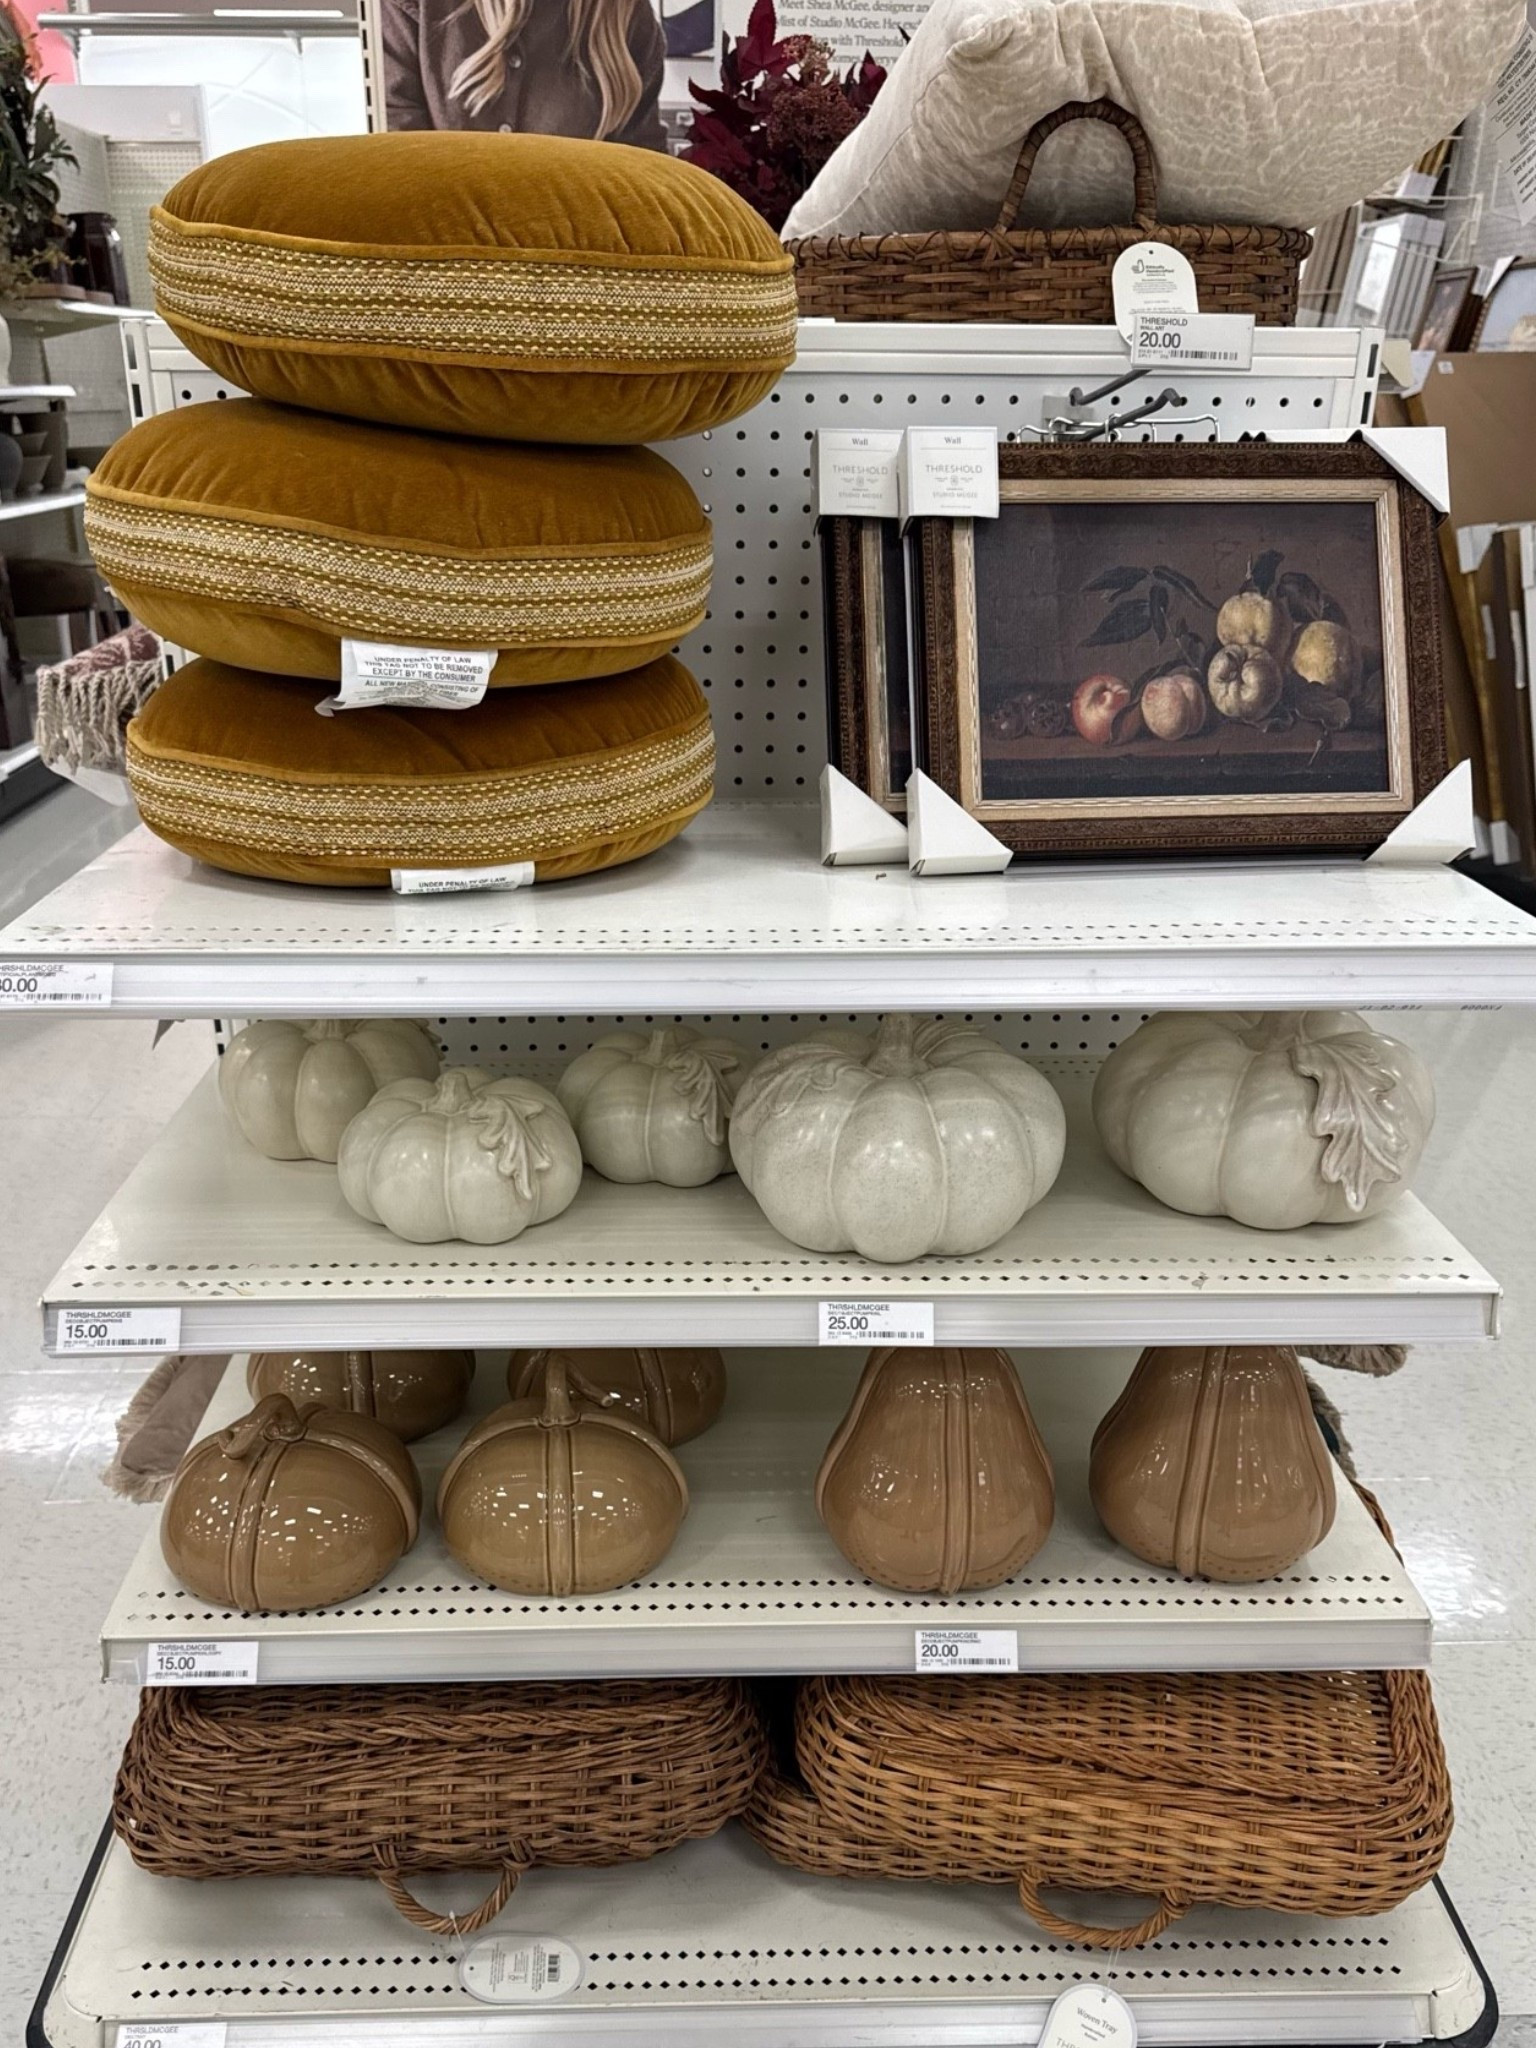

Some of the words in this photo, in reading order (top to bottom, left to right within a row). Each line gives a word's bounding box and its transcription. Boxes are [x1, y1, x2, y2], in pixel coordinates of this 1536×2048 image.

[779, 0, 805, 10] Meet
[806, 0, 832, 10] Shea
[872, 0, 915, 15] designer
[916, 4, 931, 13] an
[797, 15, 809, 27] of
[810, 16, 843, 28] Studio
[882, 18, 900, 30] Her
[831, 35, 853, 47] with
[854, 35, 904, 48] Threshold
[1141, 316, 1188, 326] THRESHOLD
[1139, 331, 1182, 349] 20.00
[852, 438, 869, 446] Wall
[944, 437, 962, 445] Wall
[832, 464, 889, 476] THRESHOLD
[925, 463, 983, 475] THRESHOLD
[373, 667, 403, 676] EXCEPT
[405, 670, 416, 678] BY
[417, 670, 433, 680] THE
[434, 672, 476, 683] CONSUMER
[422, 662, 433, 670] TO
[434, 663, 445, 671] BE
[446, 663, 484, 675] REMOVED
[445, 880, 479, 888] PENALTY
[0, 964, 65, 972] HRSHLDMCGEE
[0, 977, 38, 993] 0.00
[828, 1303, 890, 1311] THRSHLDMCGEE
[66, 1311, 132, 1319] THRSHLDMCGEE
[828, 1316, 869, 1330] 25.00
[66, 1324, 108, 1339] 15.00
[157, 1643, 218, 1651] THRSHLDMCGEE
[921, 1644, 959, 1657] 20.00
[157, 1656, 196, 1670] 15.00
[1077, 2007, 1101, 2026] Woven
[1102, 2019, 1119, 2035] Tray
[123, 2039, 162, 2048] 4000
